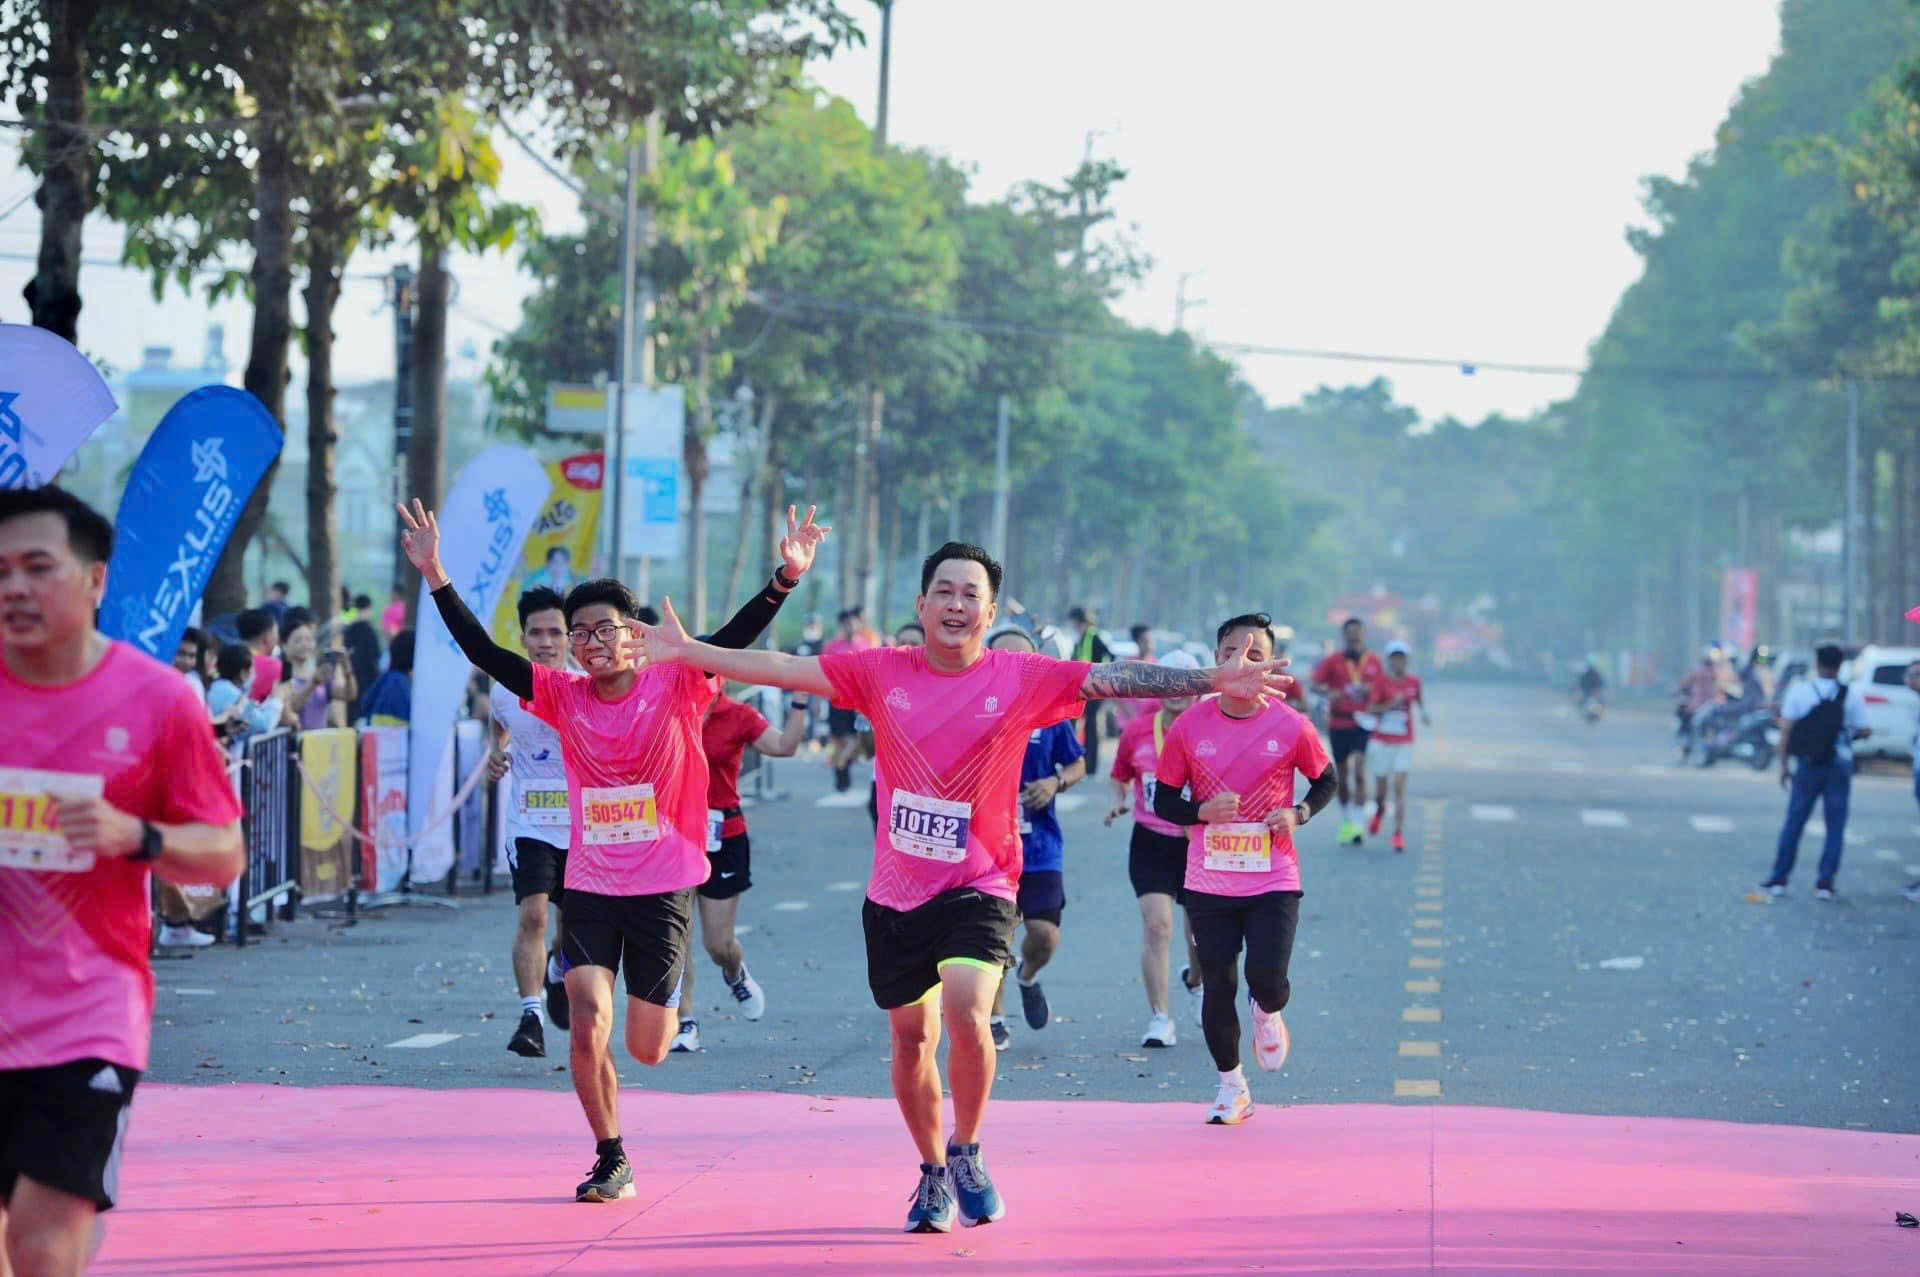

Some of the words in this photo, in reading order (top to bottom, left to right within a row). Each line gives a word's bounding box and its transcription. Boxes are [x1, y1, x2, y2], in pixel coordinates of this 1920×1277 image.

[138, 479, 232, 655] NEXUS
[592, 800, 646, 824] 50547
[899, 807, 960, 840] 10132
[1212, 834, 1262, 853] 50770
